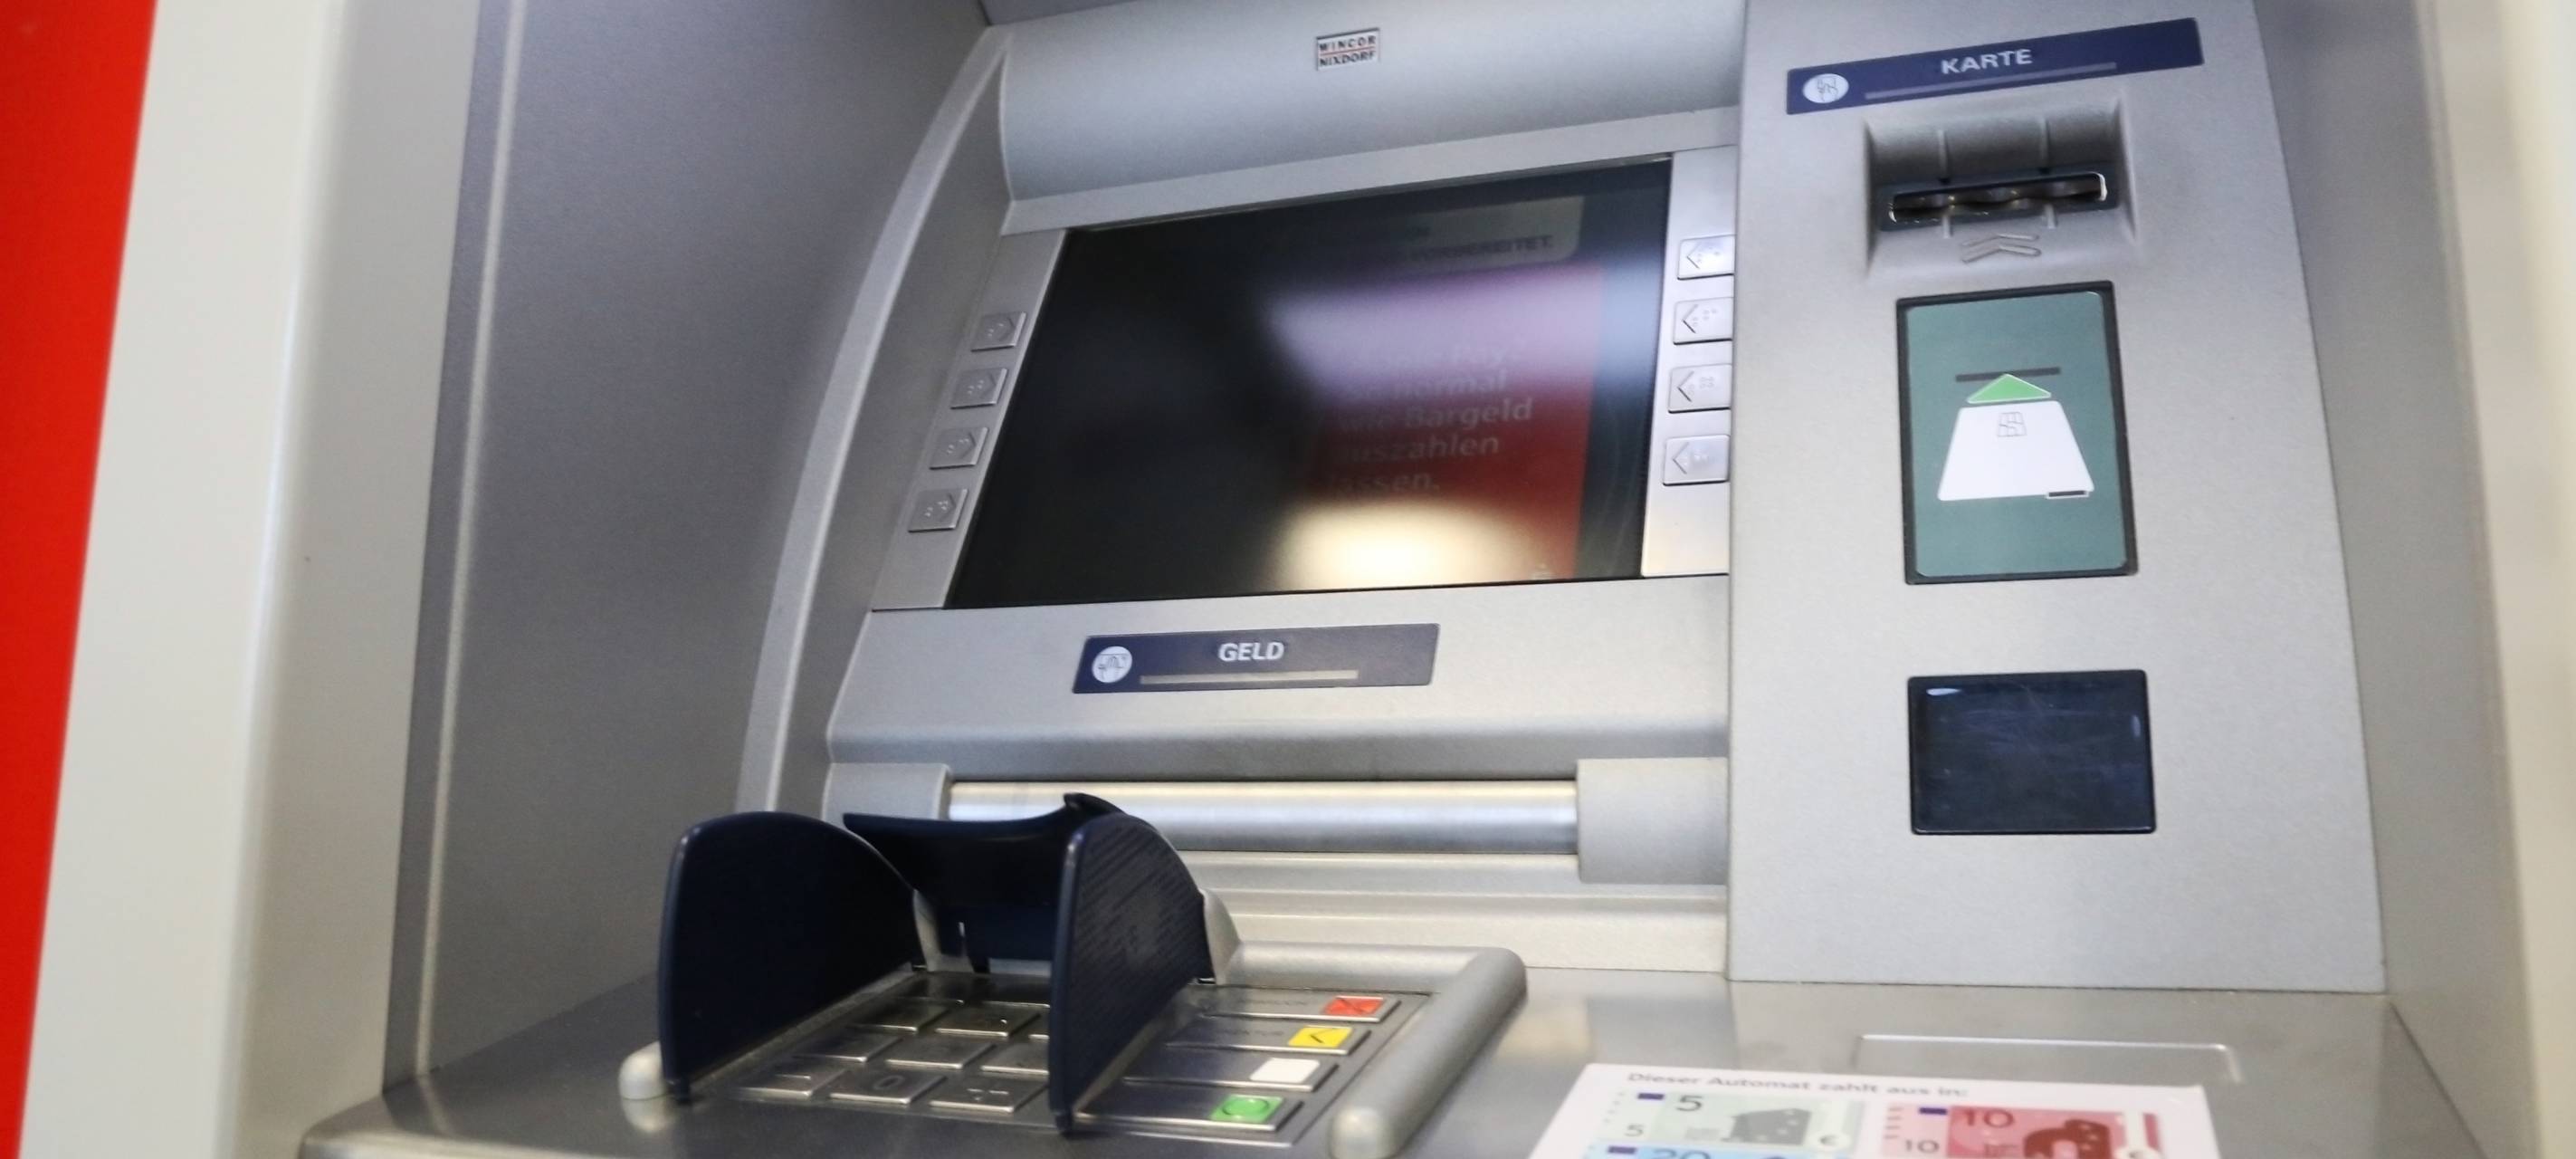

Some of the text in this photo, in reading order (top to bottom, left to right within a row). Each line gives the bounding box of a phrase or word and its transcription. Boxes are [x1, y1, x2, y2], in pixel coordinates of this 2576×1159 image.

[1319, 34, 1377, 52] WINCOR
[1319, 50, 1377, 67] NIXDORF
[1941, 48, 2034, 75] KARTE
[1395, 369, 1509, 398] normal
[1405, 397, 1533, 431] Bargeld
[1333, 435, 1500, 464] auszahlen
[1217, 641, 1285, 663] GELD
[1628, 1072, 1701, 1086] Dieser
[1708, 1077, 1810, 1091] Automat
[1818, 1082, 1880, 1095] zahlt
[1886, 1086, 1931, 1096] aus
[1675, 1095, 1703, 1112] 5
[1961, 1108, 2016, 1129] 10
[1625, 1124, 1645, 1137] 5
[1904, 1139, 1940, 1154] 10
